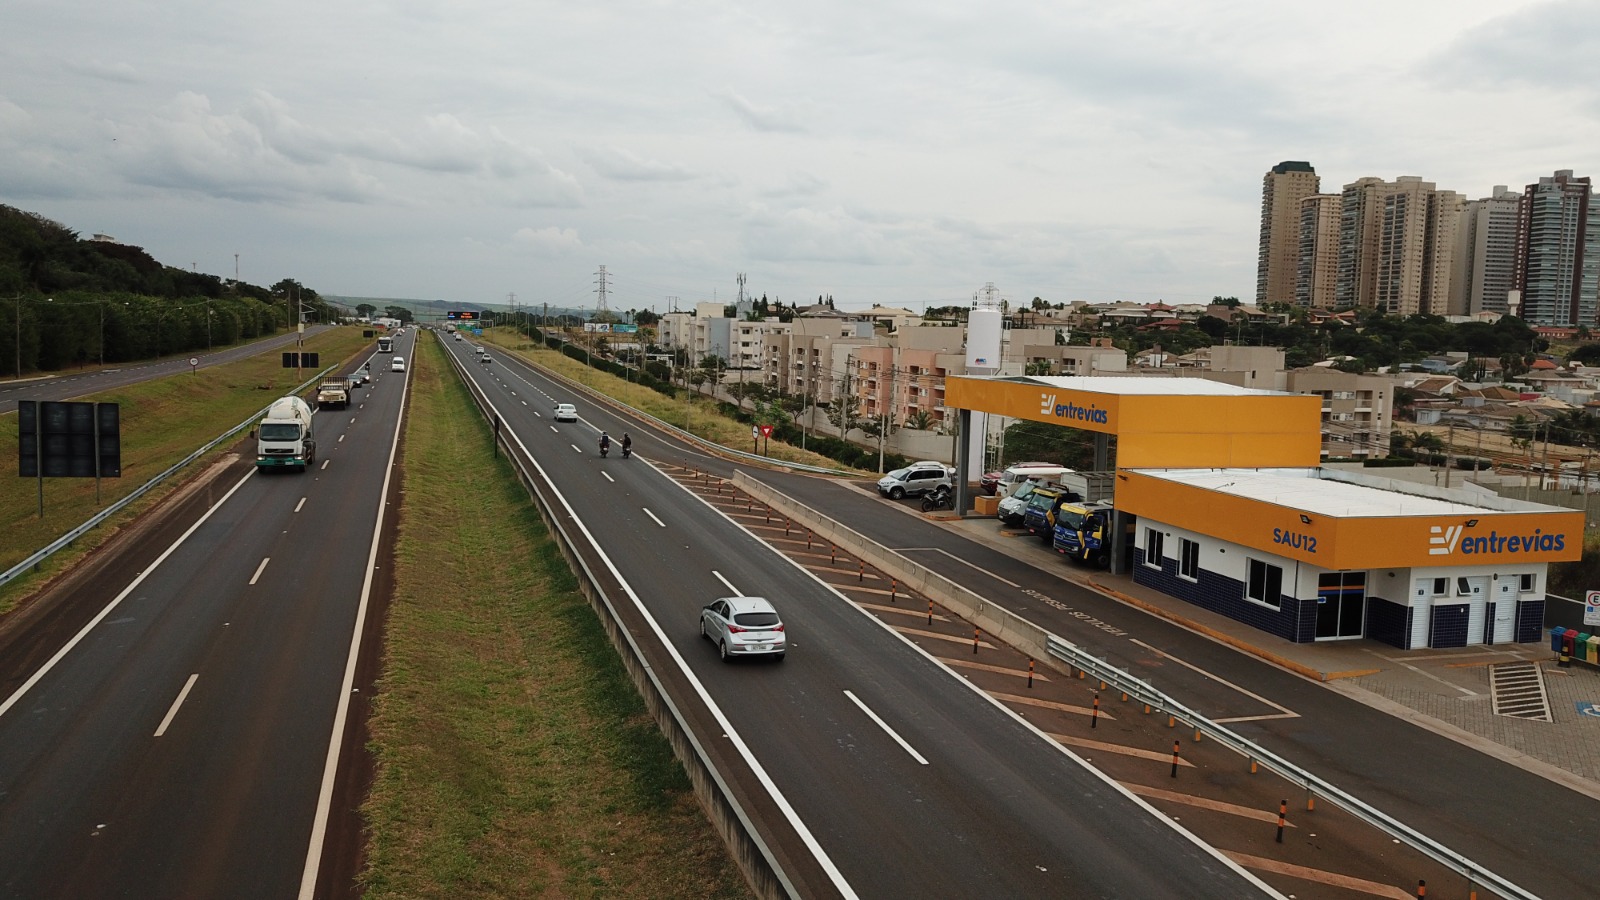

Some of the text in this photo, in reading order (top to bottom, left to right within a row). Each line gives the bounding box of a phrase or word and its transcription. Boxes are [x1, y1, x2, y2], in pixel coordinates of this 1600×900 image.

[1055, 403, 1107, 423] entrevias
[1274, 528, 1317, 553] SAU12
[1461, 529, 1565, 554] entrevias
